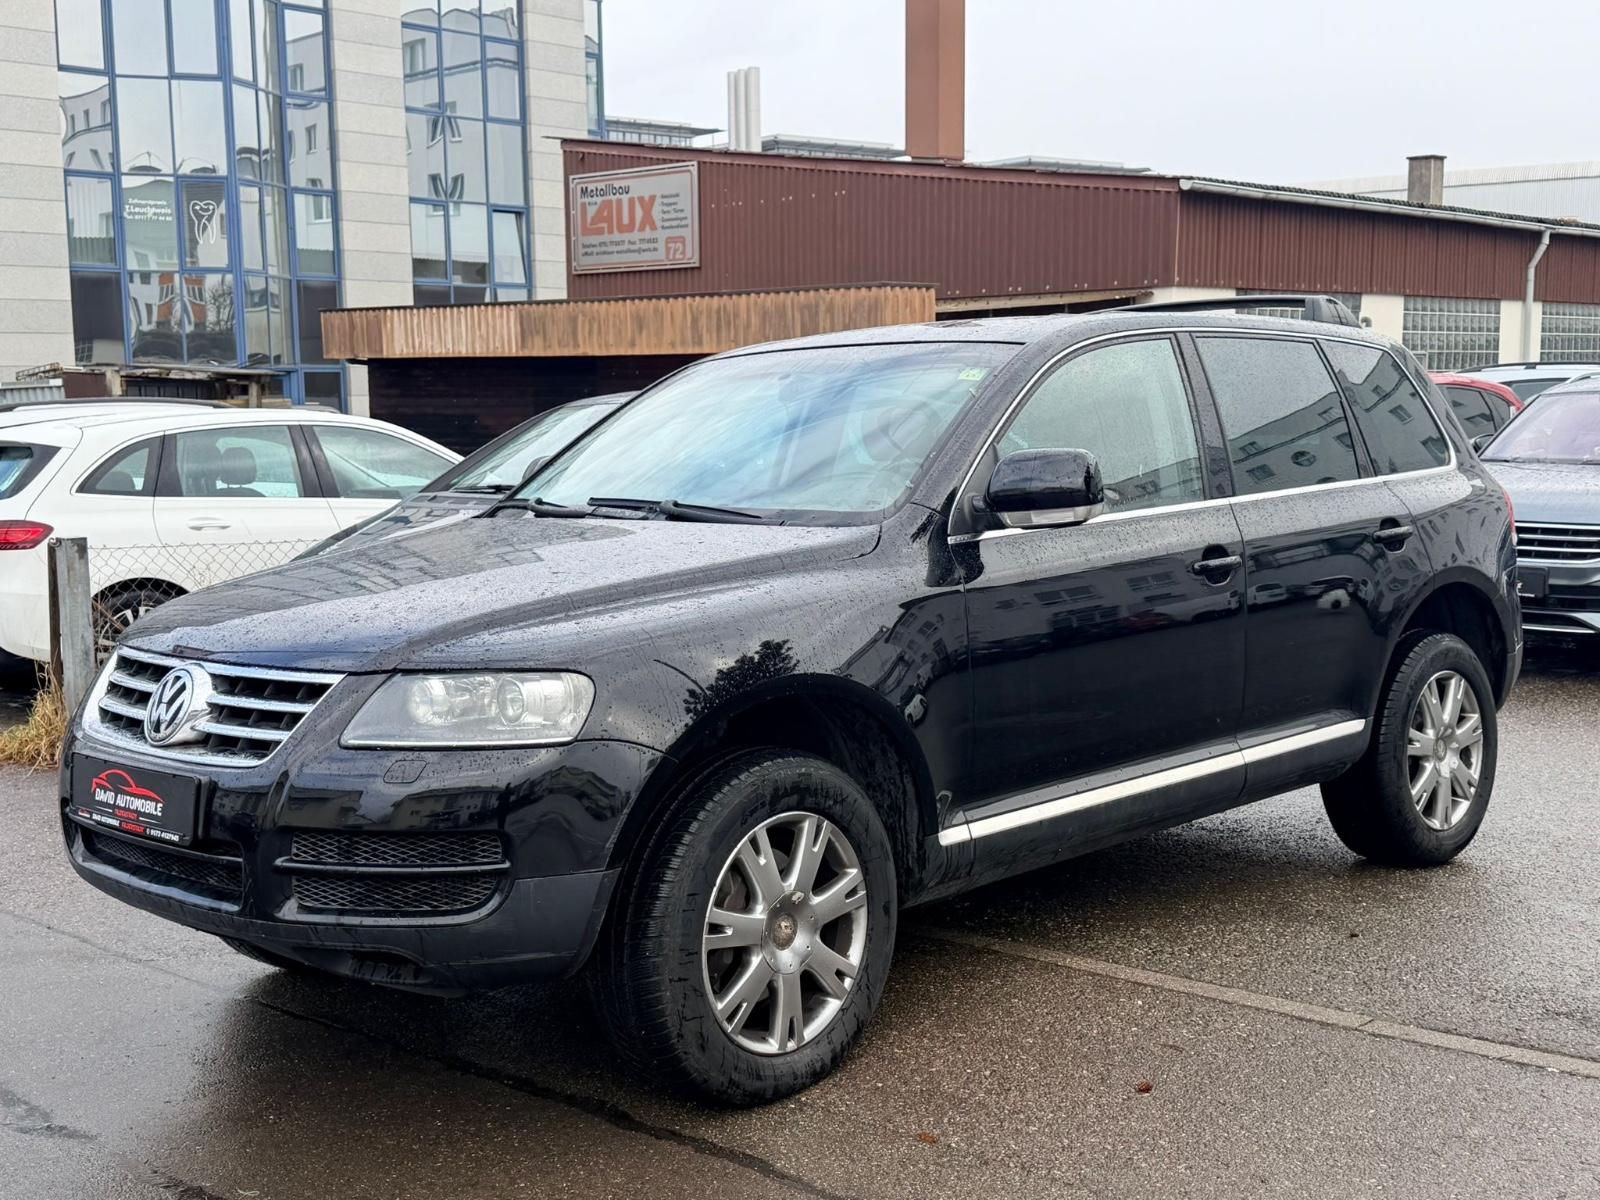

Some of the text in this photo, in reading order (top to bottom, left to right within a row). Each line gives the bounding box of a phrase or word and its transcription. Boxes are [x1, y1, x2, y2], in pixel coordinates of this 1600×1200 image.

[580, 184, 630, 199] Metallbau
[580, 194, 657, 237] LAUX
[668, 243, 684, 259] 72
[95, 788, 163, 816] DAVID AUTOMOBILE
